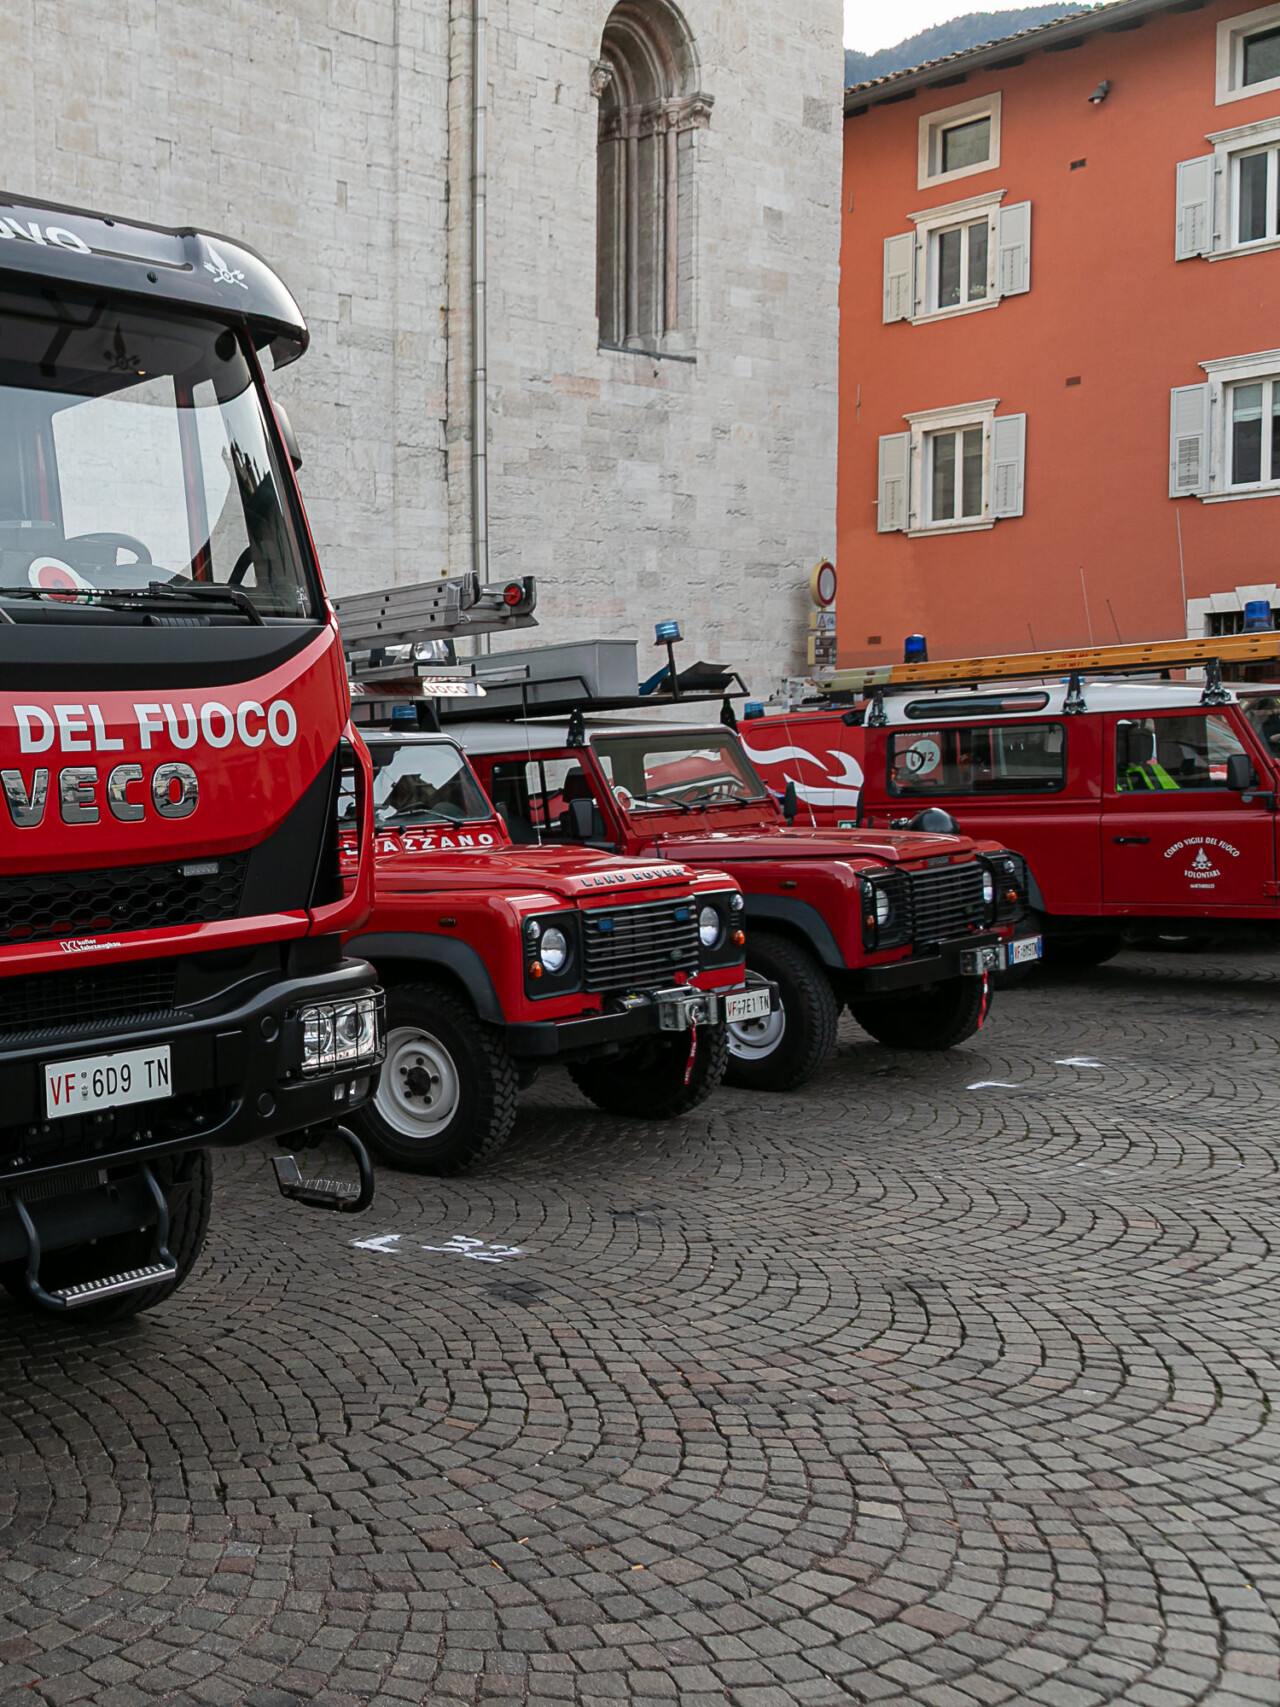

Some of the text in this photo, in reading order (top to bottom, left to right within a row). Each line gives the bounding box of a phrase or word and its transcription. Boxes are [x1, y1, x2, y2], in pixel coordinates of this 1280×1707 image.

[417, 685, 469, 694] UOCO
[12, 704, 125, 755] DEL
[133, 699, 298, 750] FUOCO
[1164, 837, 1240, 858] CORPO VIGILI DEL FUOCO
[581, 867, 684, 888] LAND ROVER
[1184, 869, 1221, 879] VOLONTARI
[727, 995, 769, 1016] VF 7E1 TN
[50, 1058, 169, 1106] VF 6D9 TN
